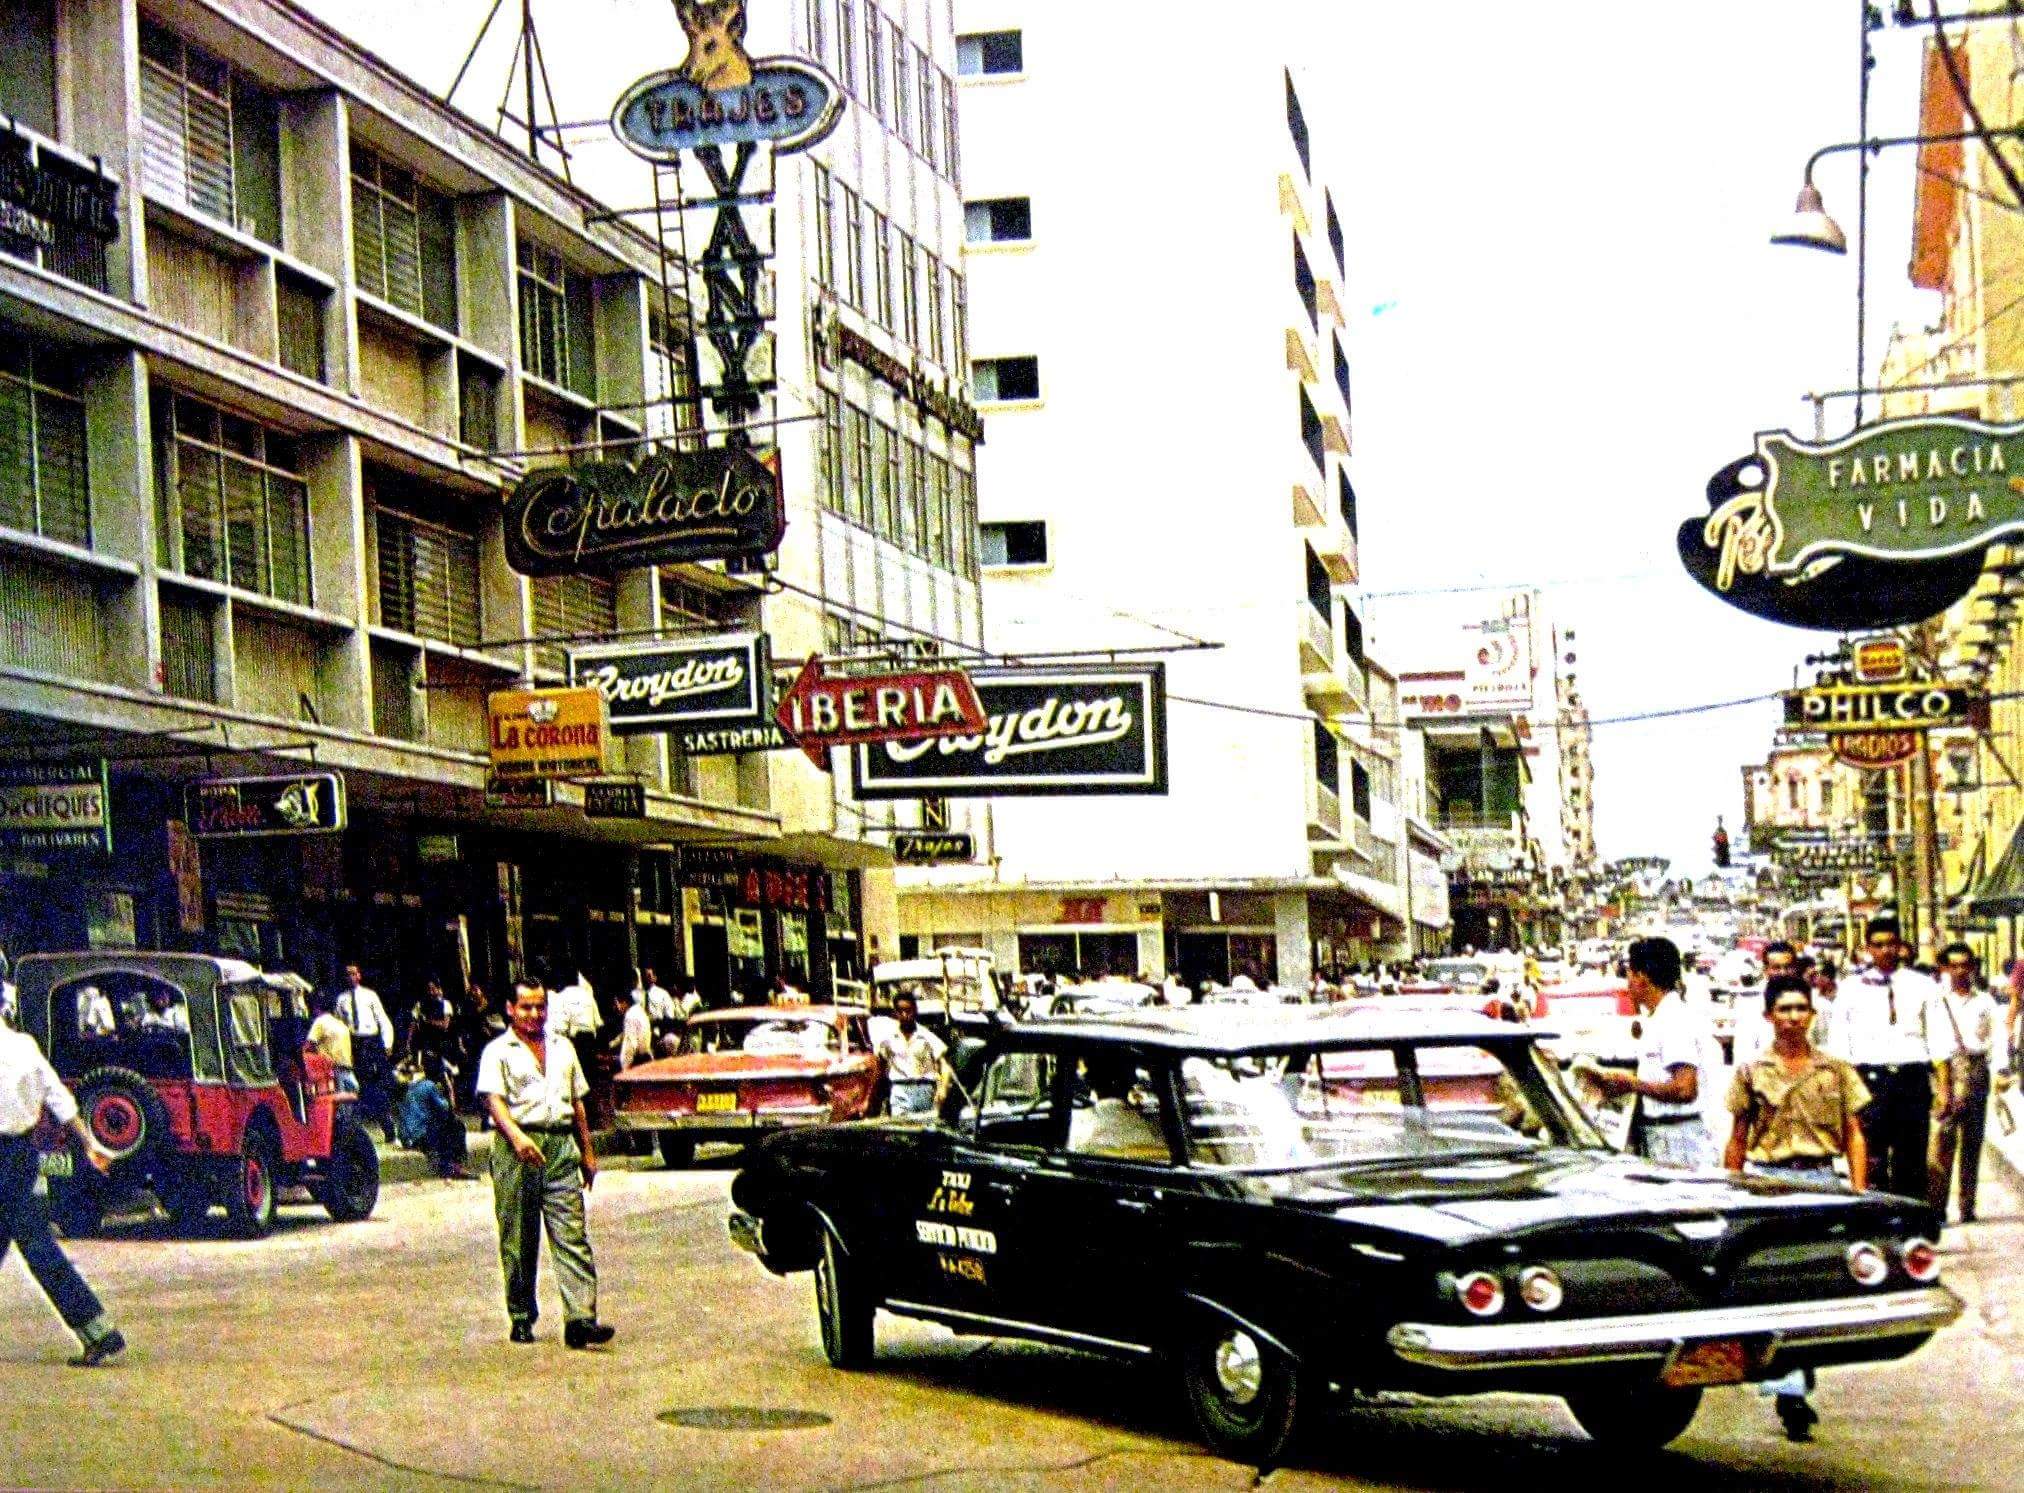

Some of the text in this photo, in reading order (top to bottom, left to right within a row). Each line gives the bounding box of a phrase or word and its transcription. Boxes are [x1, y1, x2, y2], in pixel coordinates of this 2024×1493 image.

[646, 84, 808, 135] TRAJES
[1828, 444, 2007, 488] FARMACIA
[1858, 494, 1986, 531] VIDA
[790, 682, 964, 735] IBERIA
[1803, 691, 1951, 722] PHILCO
[684, 727, 784, 752] SASTRERIA
